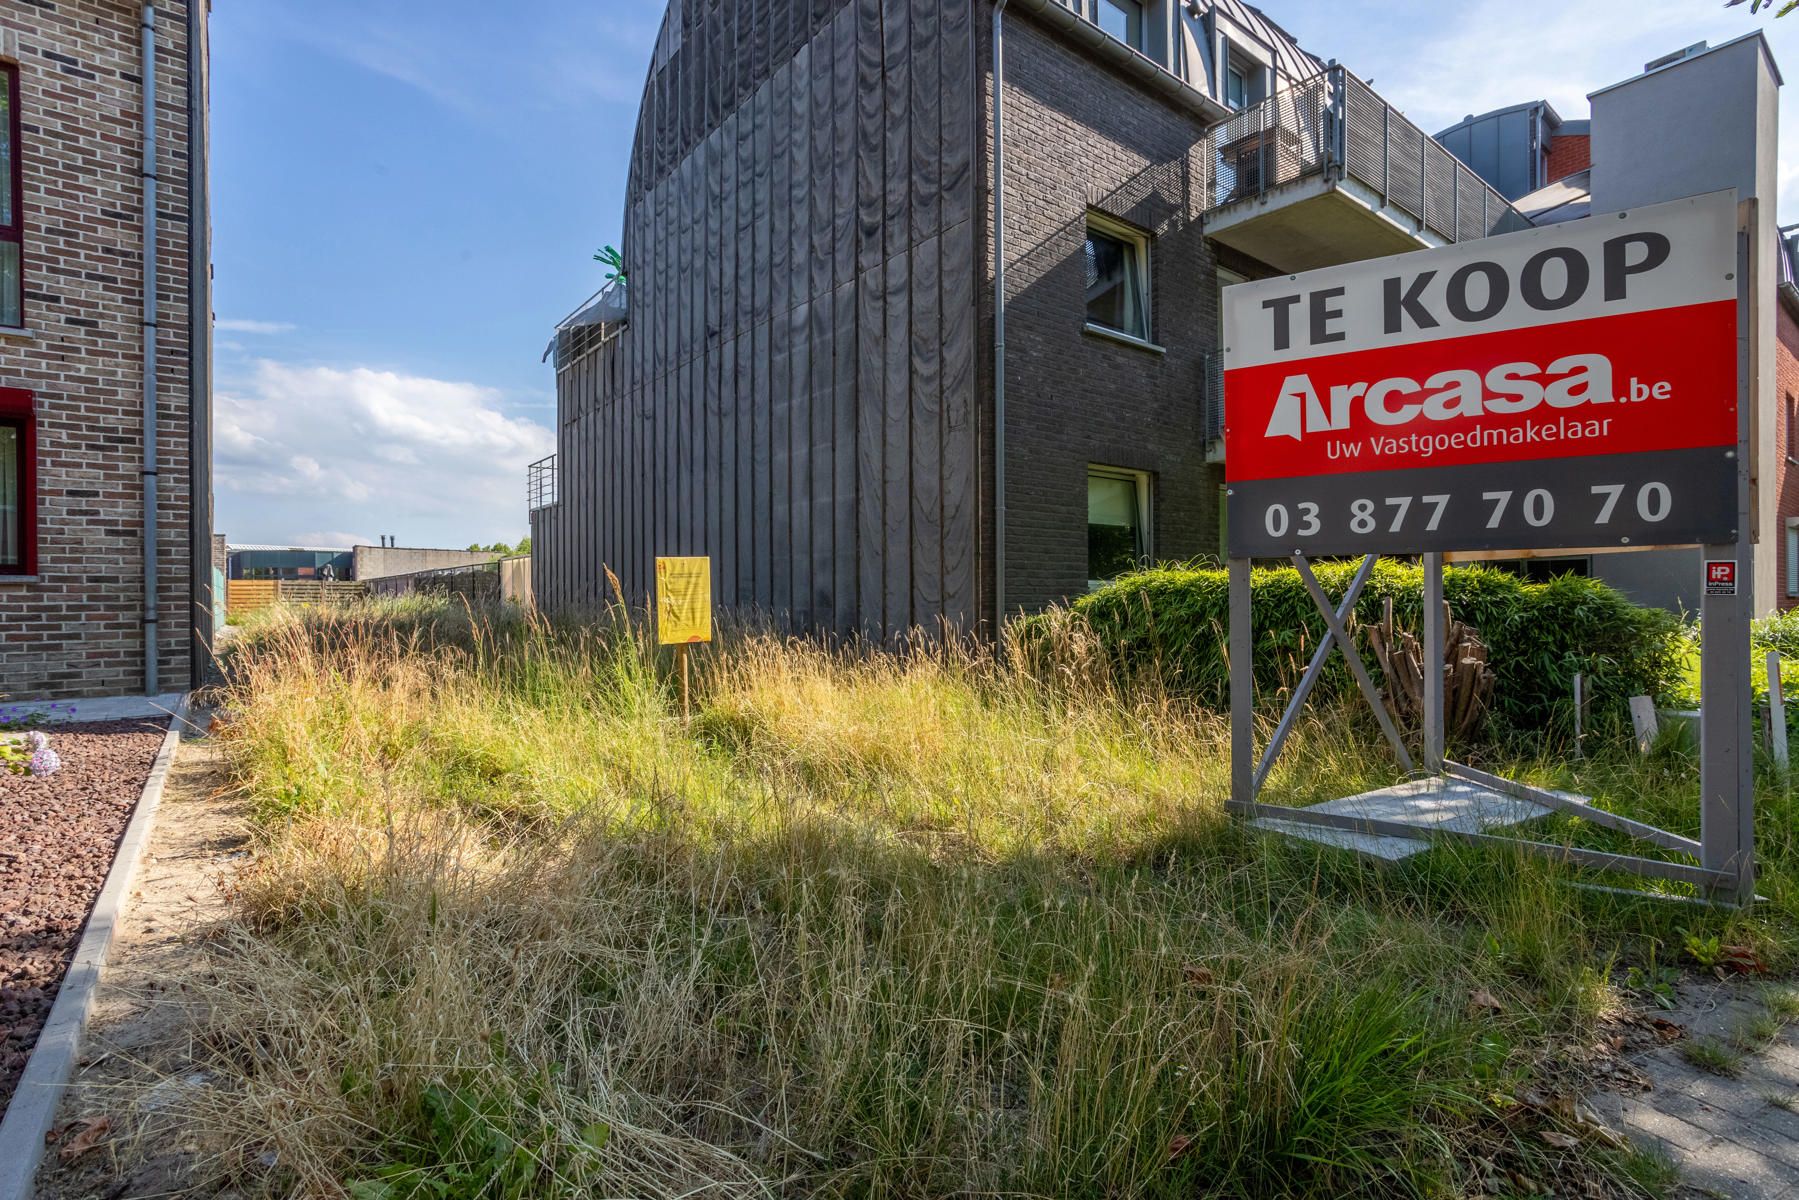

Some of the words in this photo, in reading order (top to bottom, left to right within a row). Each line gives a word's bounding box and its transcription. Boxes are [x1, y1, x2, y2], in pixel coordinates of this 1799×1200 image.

[1262, 286, 1346, 352] TE
[1382, 231, 1671, 334] KOOP
[1264, 353, 1672, 442] Arcasa.be
[1326, 440, 1361, 460] Uw
[1370, 417, 1613, 457] Vastgoedmakelaar
[1264, 501, 1322, 538] 03
[1349, 493, 1452, 535] 877
[1482, 487, 1555, 529] 70
[1590, 480, 1673, 525] 70
